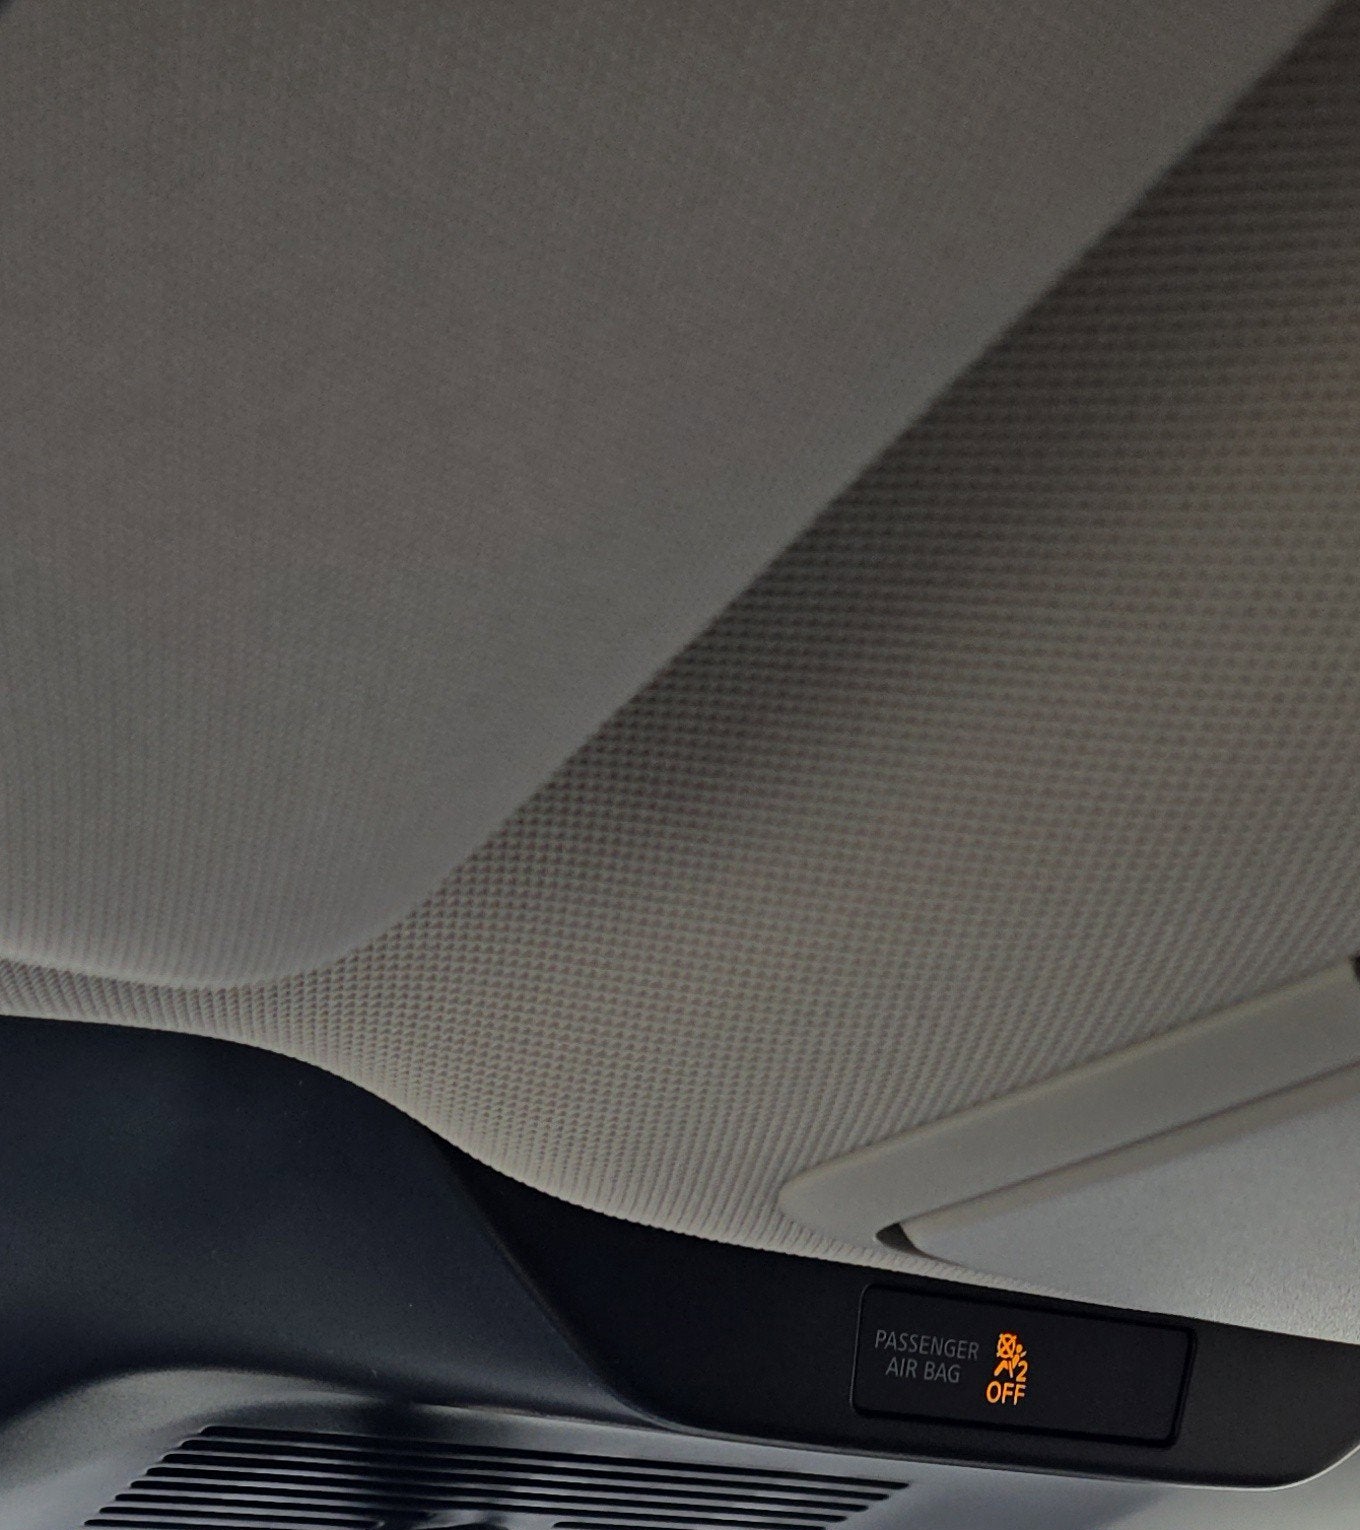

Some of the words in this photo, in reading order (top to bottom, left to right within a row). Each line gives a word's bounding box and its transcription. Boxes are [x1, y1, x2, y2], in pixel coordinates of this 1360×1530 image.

[874, 1329, 980, 1360] PASSENGER
[886, 1356, 917, 1380] AIR
[923, 1360, 961, 1384] BAG
[985, 1380, 1028, 1406] OFF
